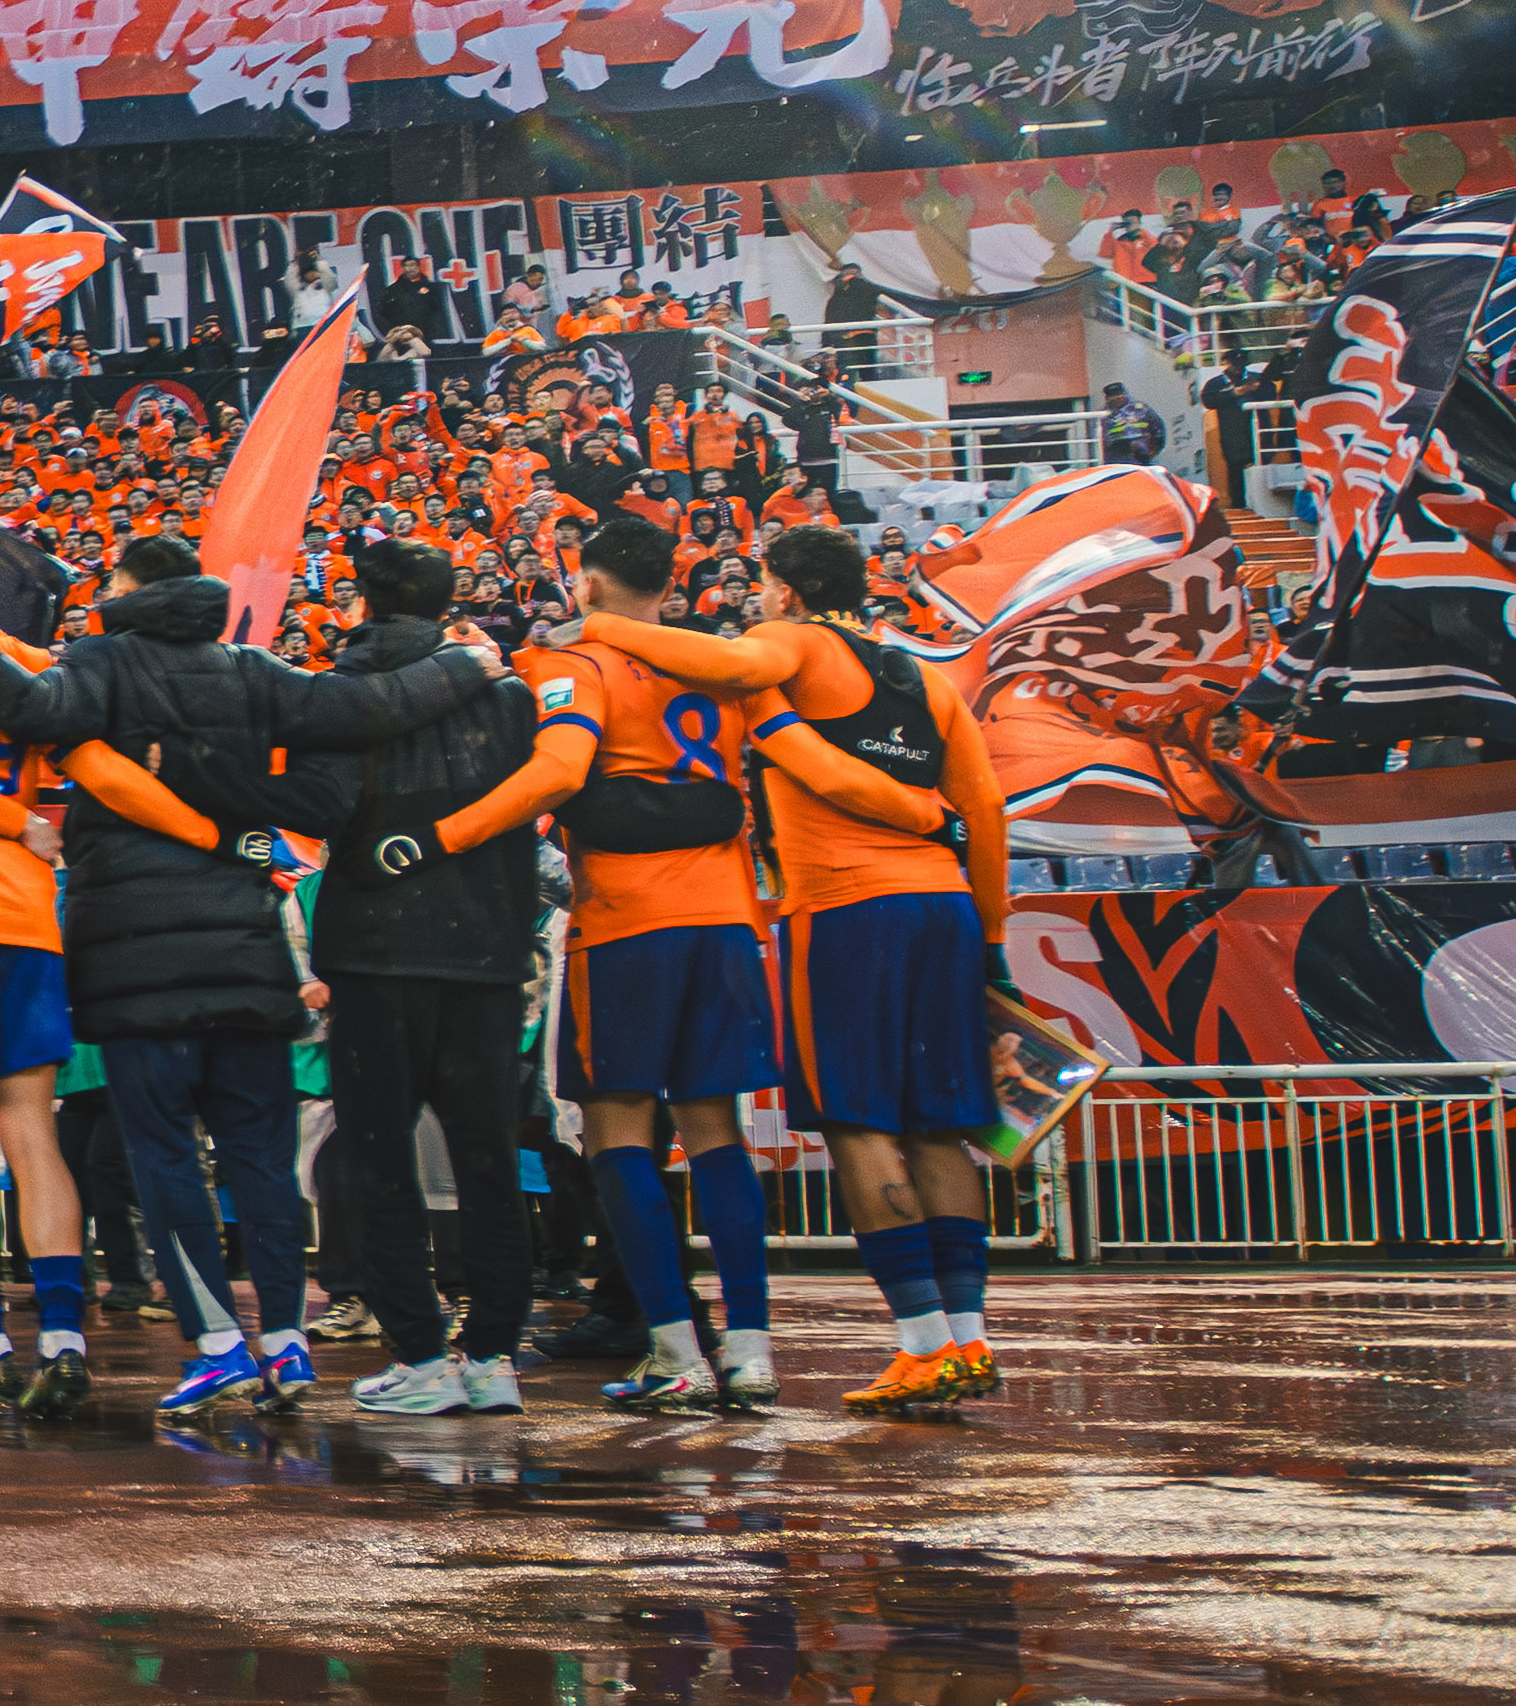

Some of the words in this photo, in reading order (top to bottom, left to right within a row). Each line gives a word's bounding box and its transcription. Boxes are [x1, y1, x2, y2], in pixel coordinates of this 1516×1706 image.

[556, 187, 743, 273] 團結
[663, 691, 728, 784] 8
[857, 738, 930, 762] CATAPULT
